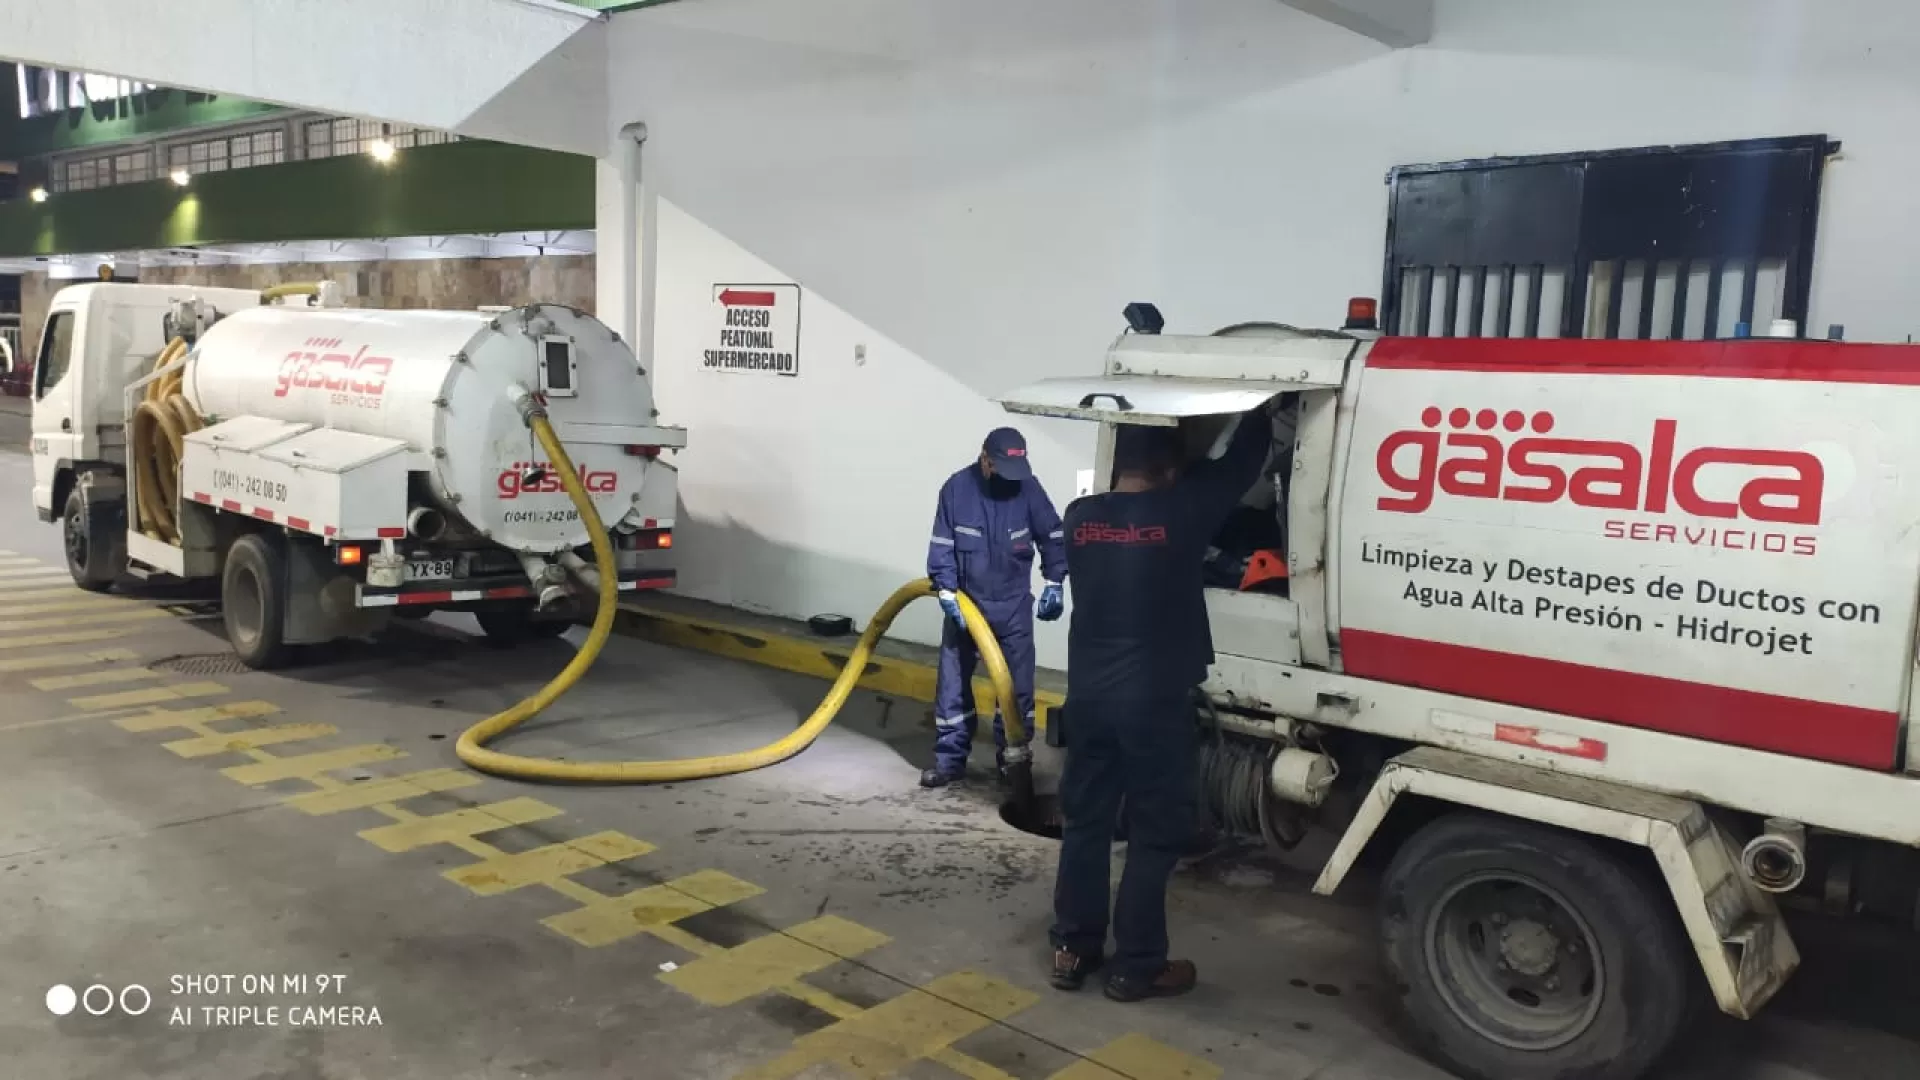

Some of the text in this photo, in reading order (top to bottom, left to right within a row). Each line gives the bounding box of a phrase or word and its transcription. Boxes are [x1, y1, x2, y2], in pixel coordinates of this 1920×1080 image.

[725, 308, 770, 328] ACCESO
[720, 329, 774, 349] PEATONAL
[704, 349, 793, 371] SUPERMERCADO
[329, 393, 382, 409] SERVCIOS
[1376, 409, 1824, 526] gasalca
[245, 475, 261, 496] 242
[545, 510, 564, 523] 242
[1073, 522, 1167, 546] gasalca
[1604, 520, 1817, 556] SERVICIOS
[1361, 542, 1880, 624] Limpieza y Destapes de Ductos con
[1403, 580, 1463, 608] Agua
[1471, 590, 1524, 615] Alta
[1535, 597, 1642, 631] Presión
[1677, 614, 1813, 655] Hidrojet
